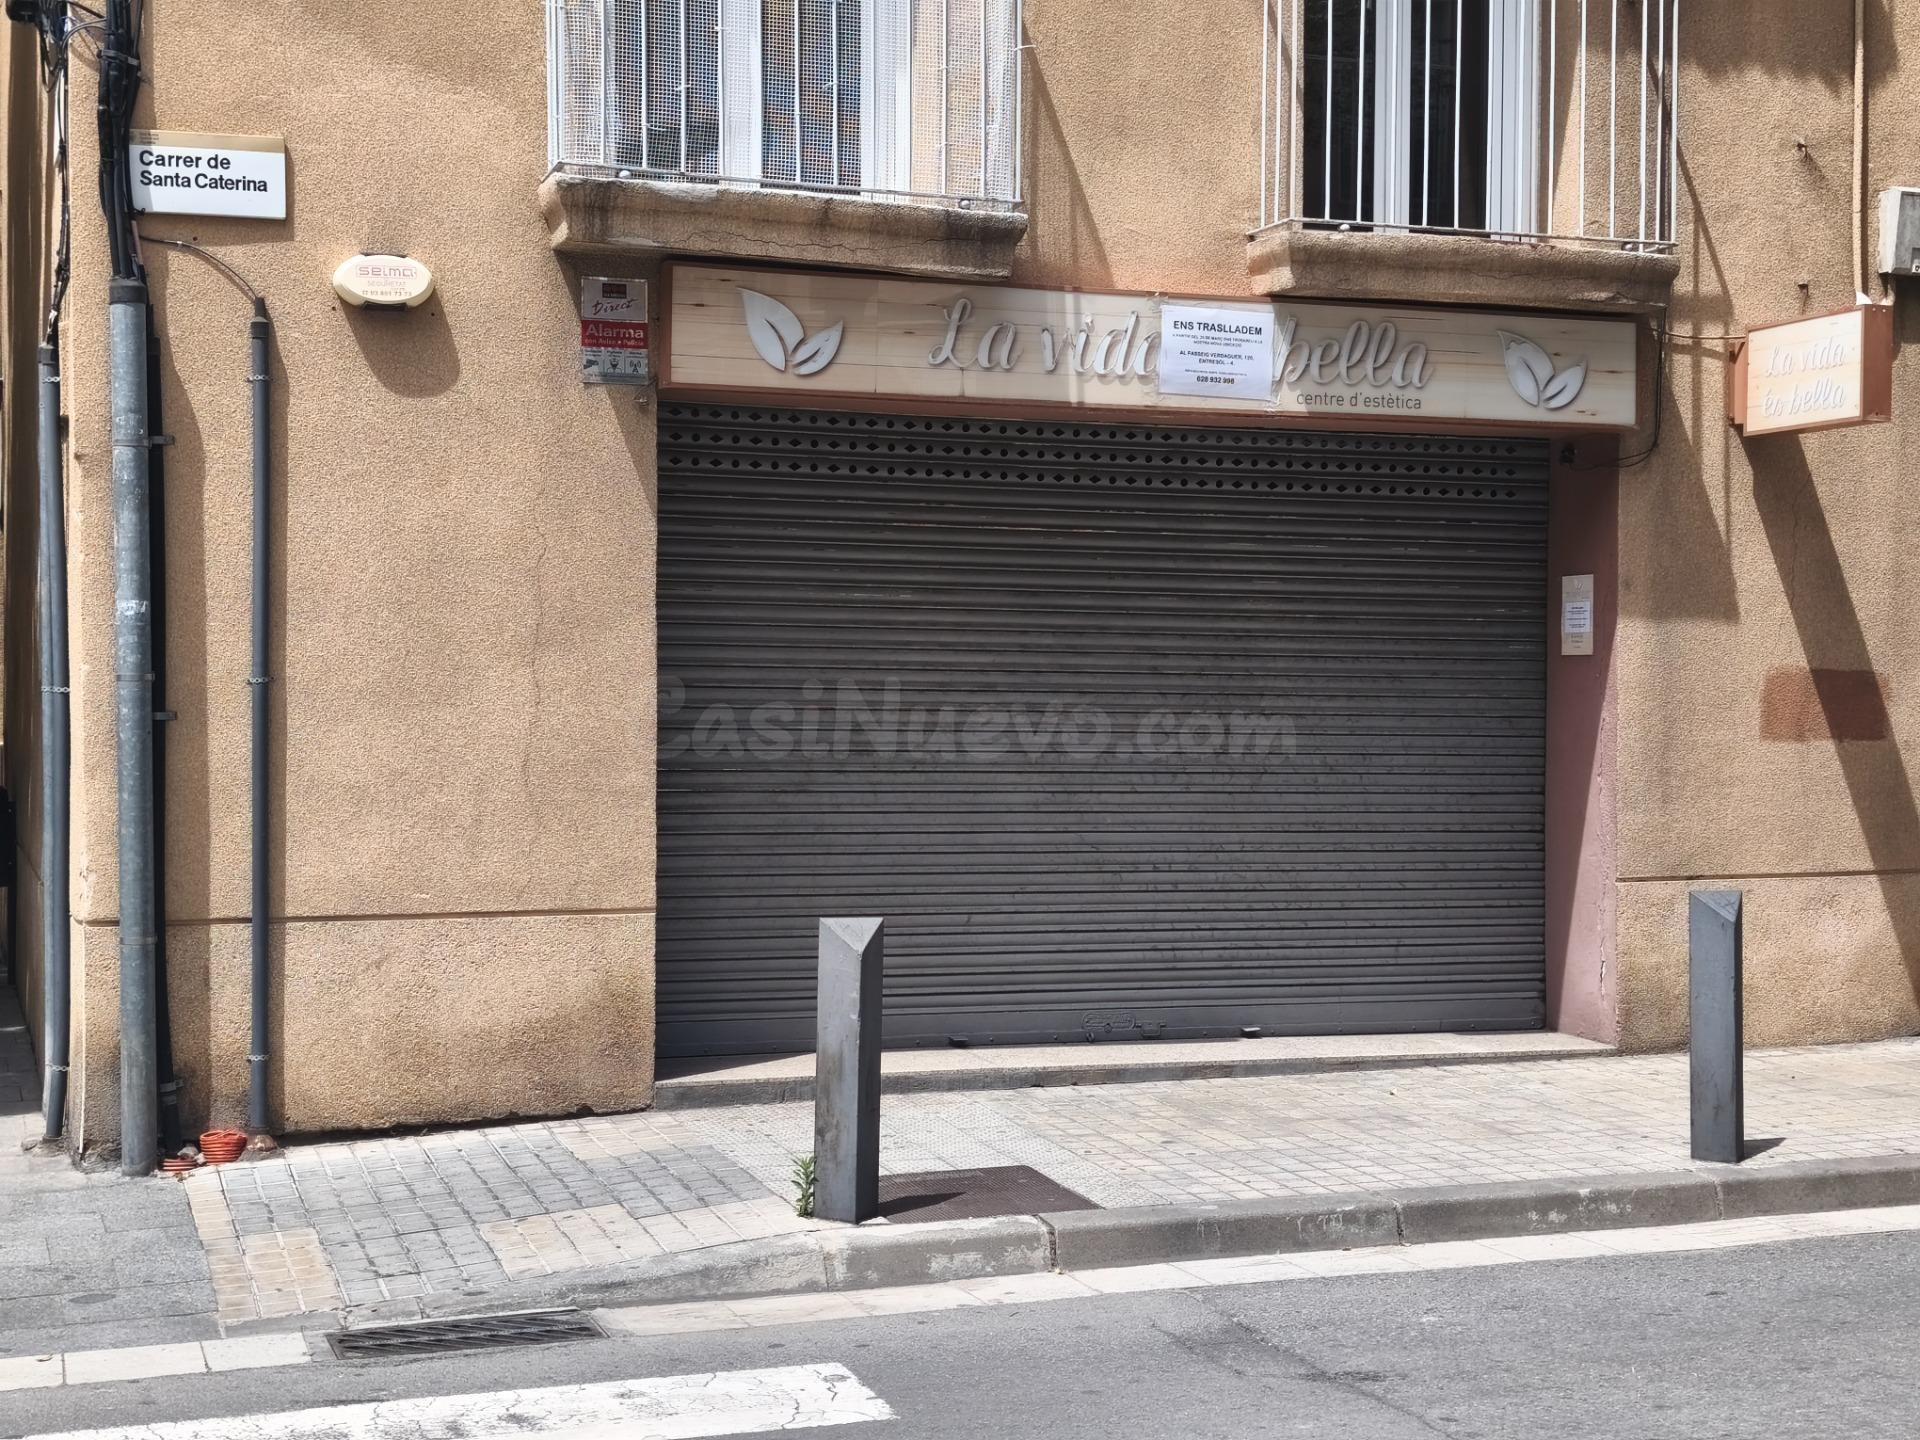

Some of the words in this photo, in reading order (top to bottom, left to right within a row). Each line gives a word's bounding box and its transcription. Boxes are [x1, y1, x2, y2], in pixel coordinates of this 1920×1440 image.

[139, 150, 202, 168] Carrer
[206, 154, 231, 170] de
[140, 170, 191, 188] Santa
[194, 173, 268, 192] Caterina
[586, 323, 644, 339] Alarma
[1173, 320, 1194, 331] ENS
[1196, 321, 1262, 336] TRASLLADEM
[928, 298, 1024, 373] La
[1041, 310, 1162, 376] vida
[1272, 315, 1435, 389] bella
[1296, 391, 1345, 407] centre
[1349, 391, 1422, 410] d'estètica
